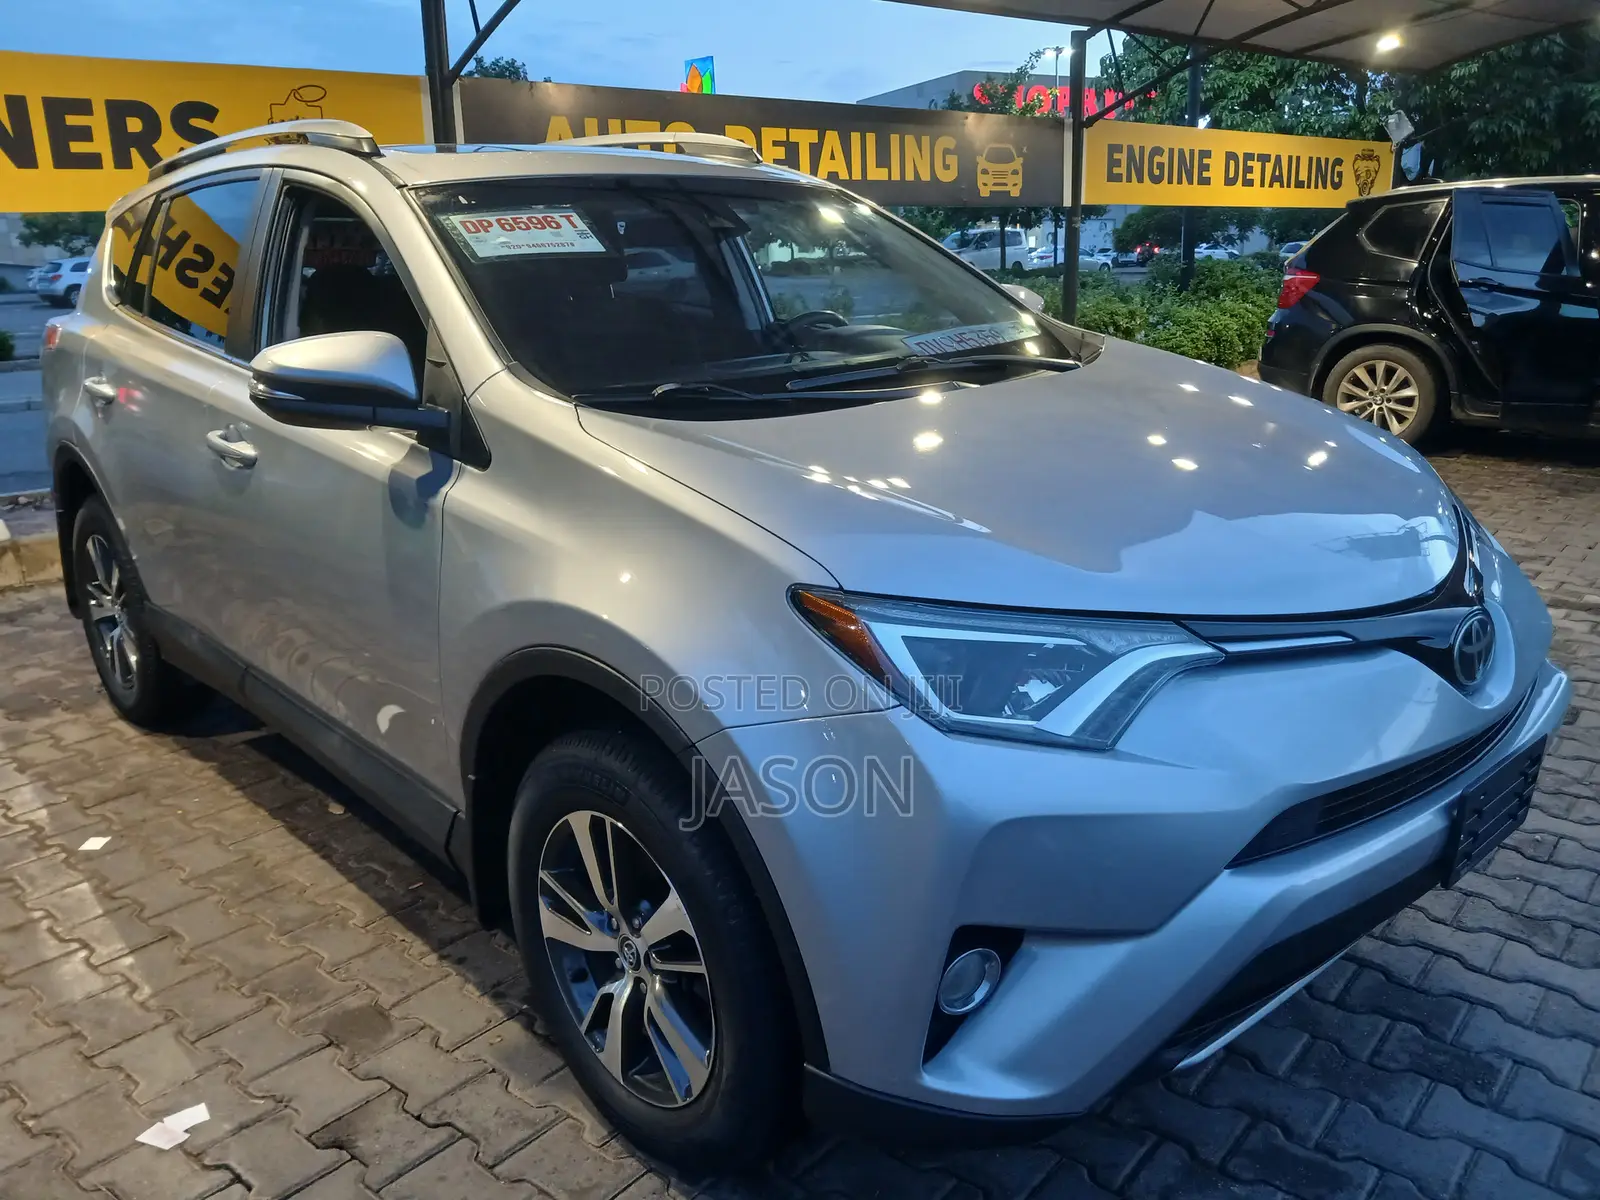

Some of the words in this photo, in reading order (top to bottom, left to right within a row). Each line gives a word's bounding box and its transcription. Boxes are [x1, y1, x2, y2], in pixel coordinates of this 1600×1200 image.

[1106, 143, 1212, 186] ENGINE
[1223, 150, 1344, 191] DETAILING
[458, 219, 494, 235] DP
[495, 214, 562, 233] 6596
[558, 214, 579, 229] T
